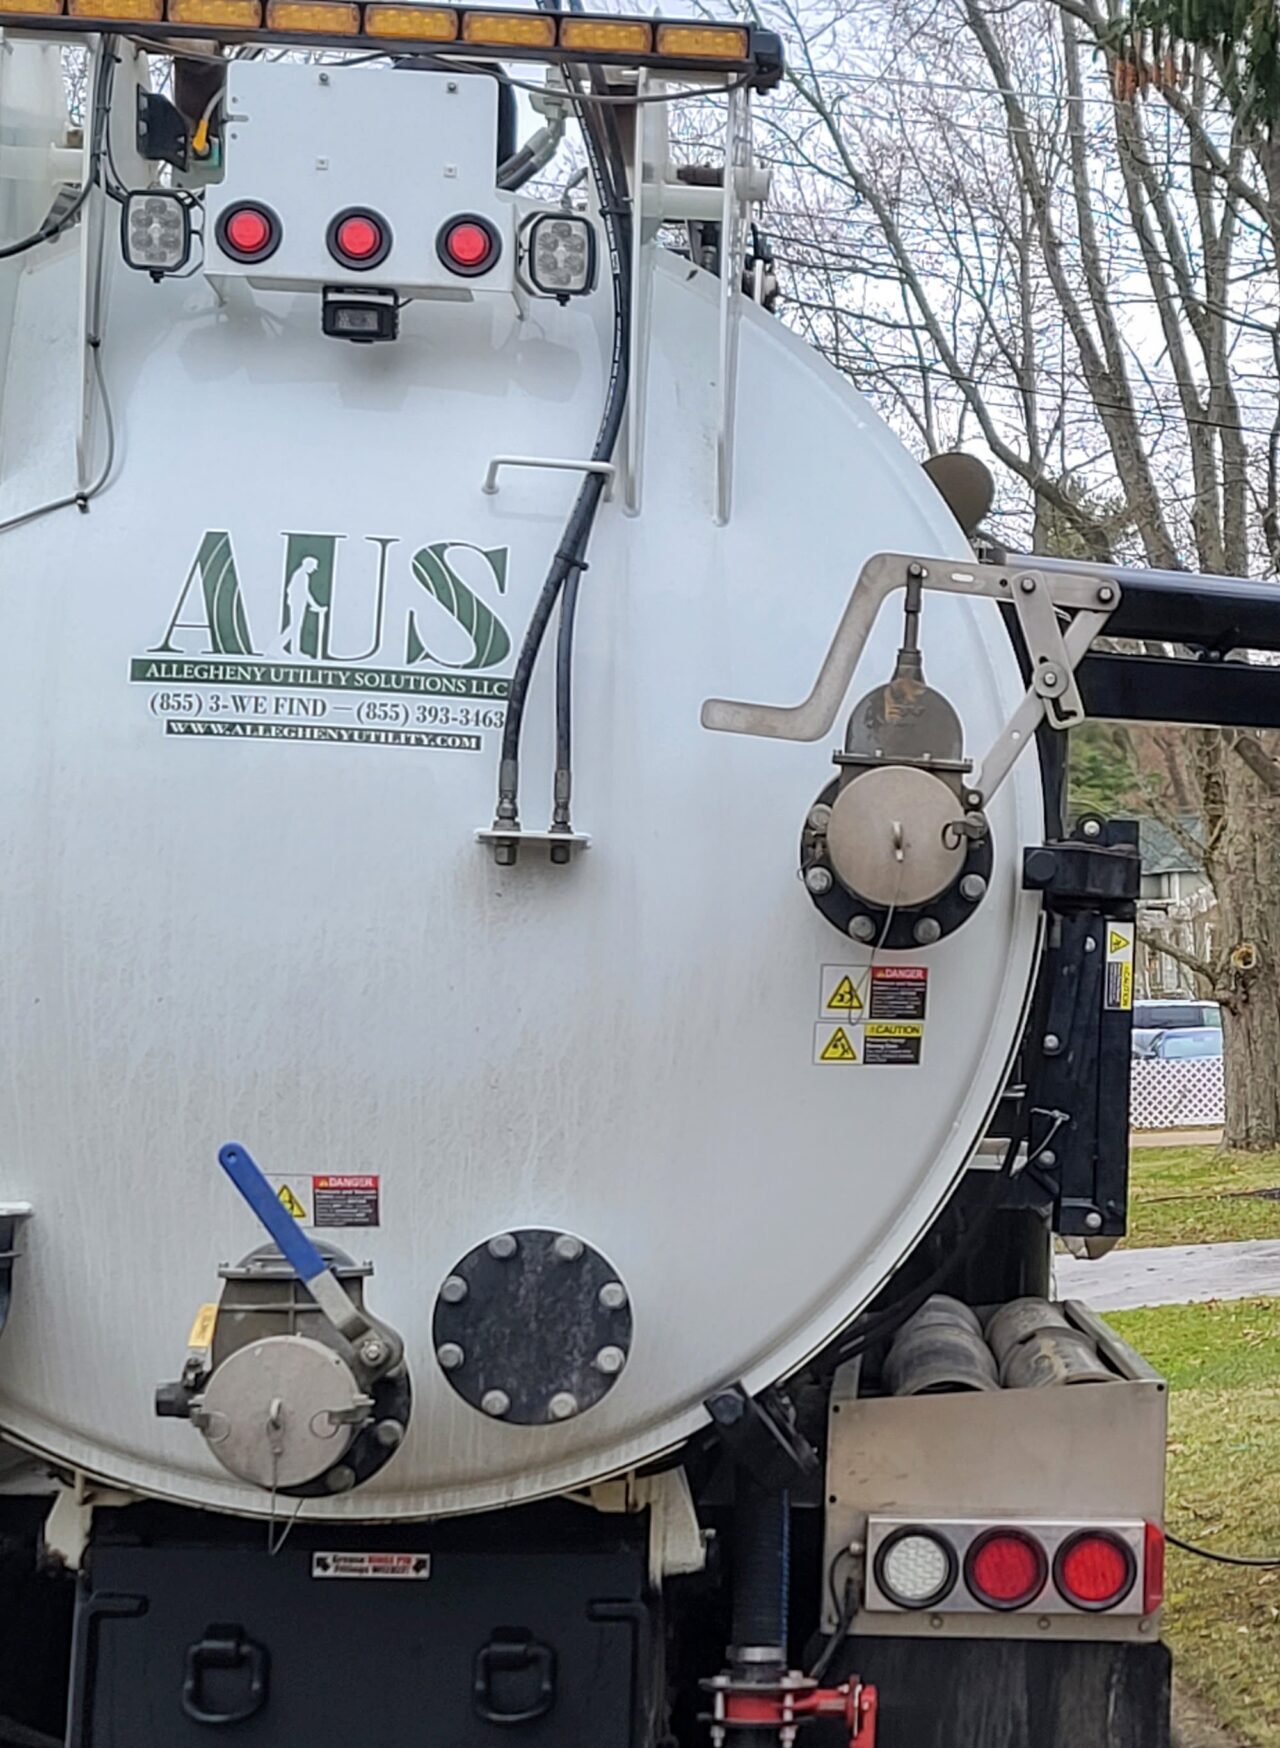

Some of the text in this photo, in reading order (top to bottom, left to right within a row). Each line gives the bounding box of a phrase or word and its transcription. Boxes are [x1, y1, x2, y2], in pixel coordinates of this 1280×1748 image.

[145, 530, 511, 670] AUS
[145, 662, 508, 697] ALLEGHENY UTILITY SOLUTIONS LLC
[149, 691, 203, 716] (855)
[208, 693, 268, 714] 3-WE
[273, 695, 327, 718] FIND
[356, 700, 410, 726] (855)
[415, 704, 506, 729] 393-3463
[168, 720, 479, 749] WWW.ALLEGHENYUTILITY.COM
[884, 968, 924, 980] DANGER
[875, 1024, 920, 1035] CAUTION
[328, 1177, 374, 1188] DANGER
